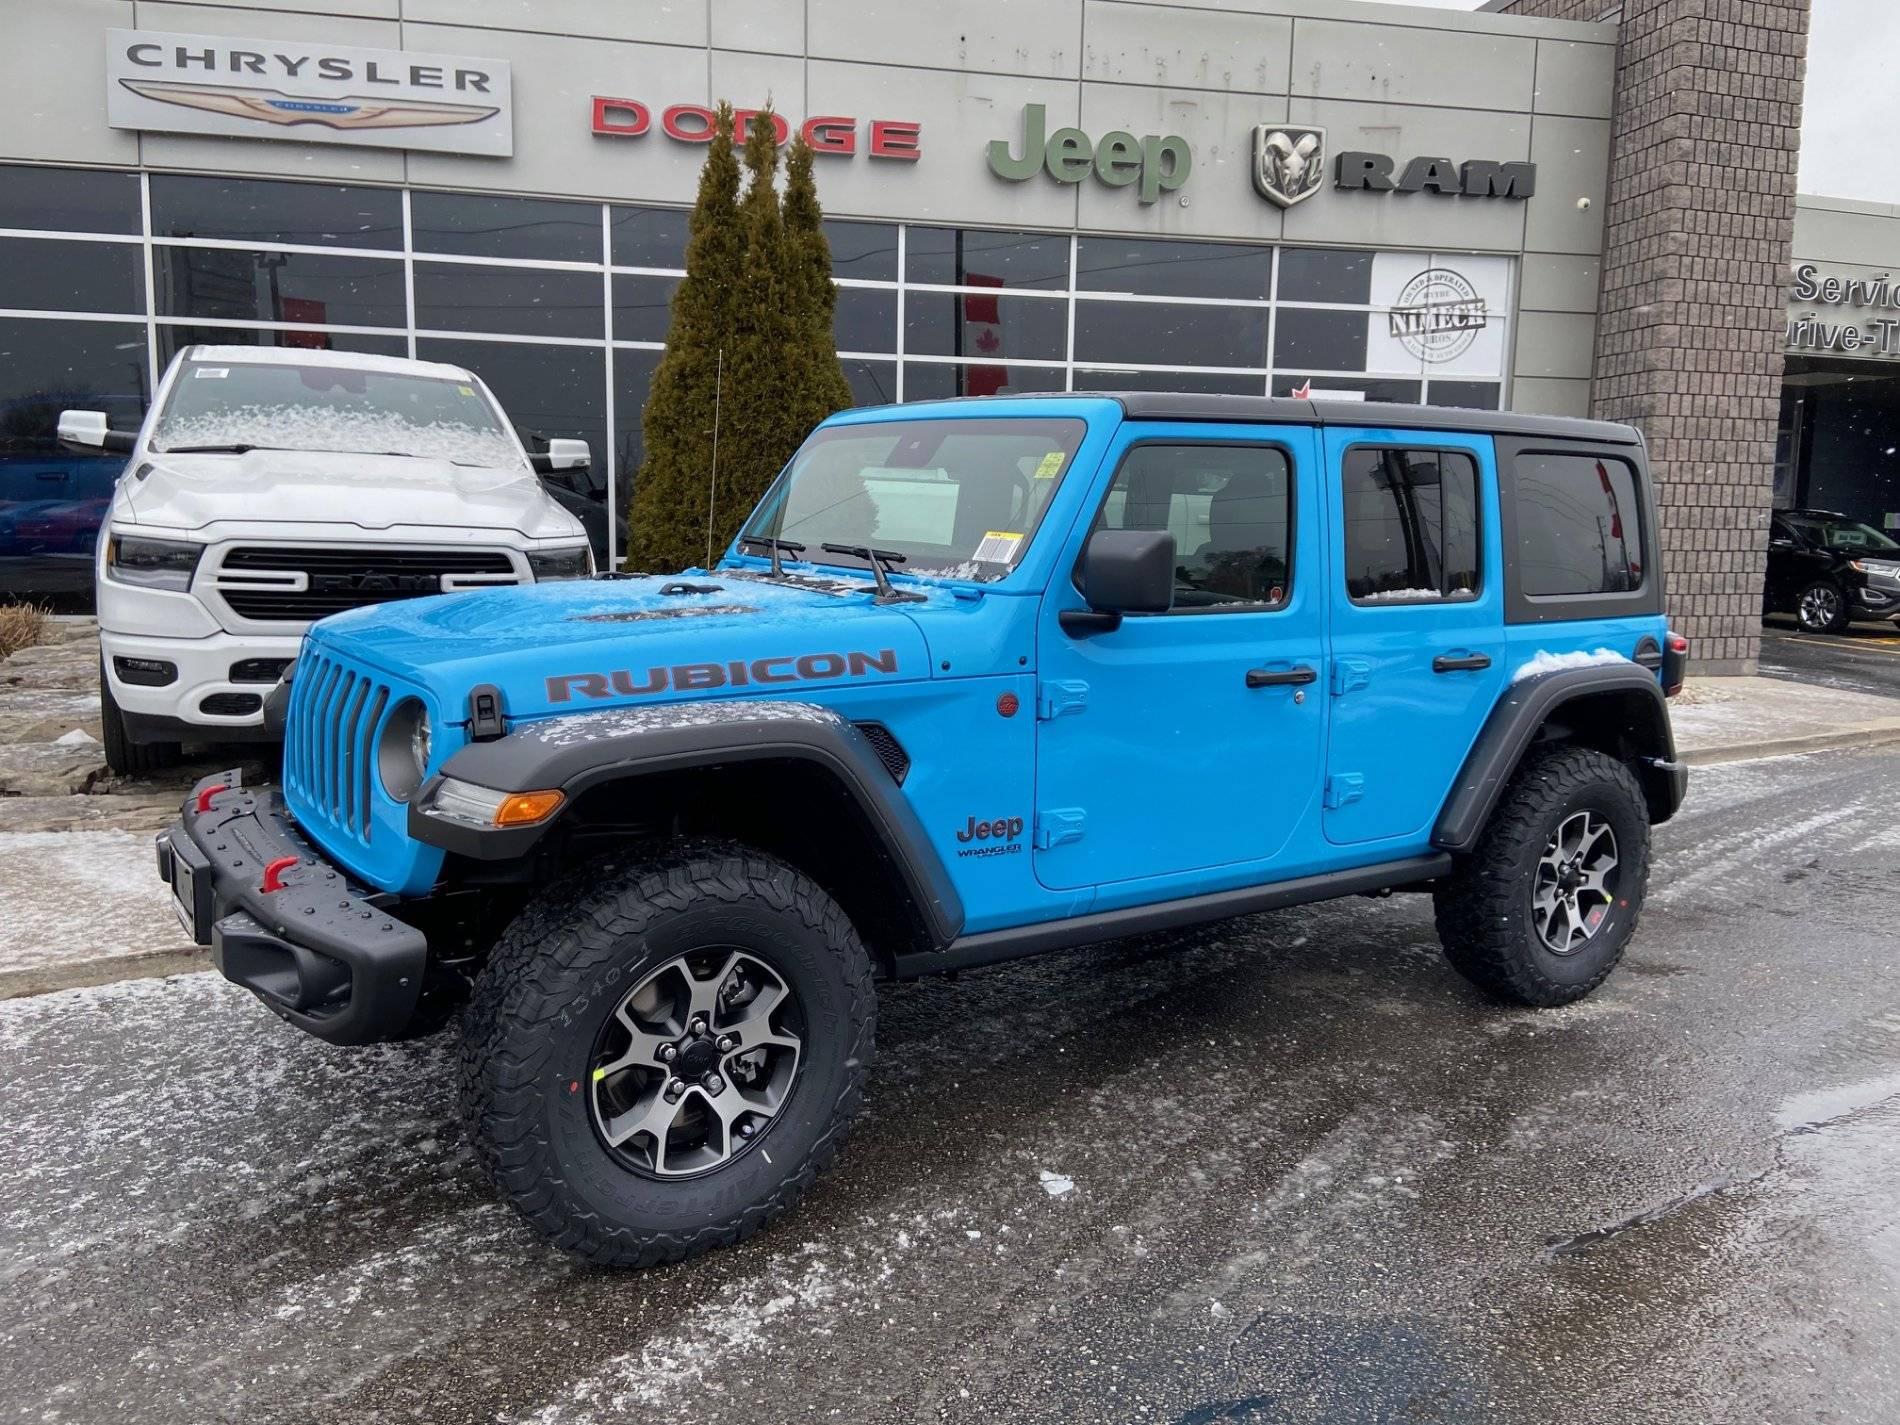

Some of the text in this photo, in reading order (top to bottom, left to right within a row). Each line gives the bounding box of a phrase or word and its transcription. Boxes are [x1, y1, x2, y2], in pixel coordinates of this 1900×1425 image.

[126, 43, 492, 93] CHRYSLER
[590, 95, 922, 161] DODGE
[986, 103, 1192, 205] Jeep
[1335, 150, 1537, 199] RAM
[1391, 302, 1486, 335] NIMECK
[310, 572, 439, 591] RAM
[544, 649, 899, 703] RUBICON
[957, 816, 1024, 842] Jeep
[957, 843, 1022, 858] WRANGLER
